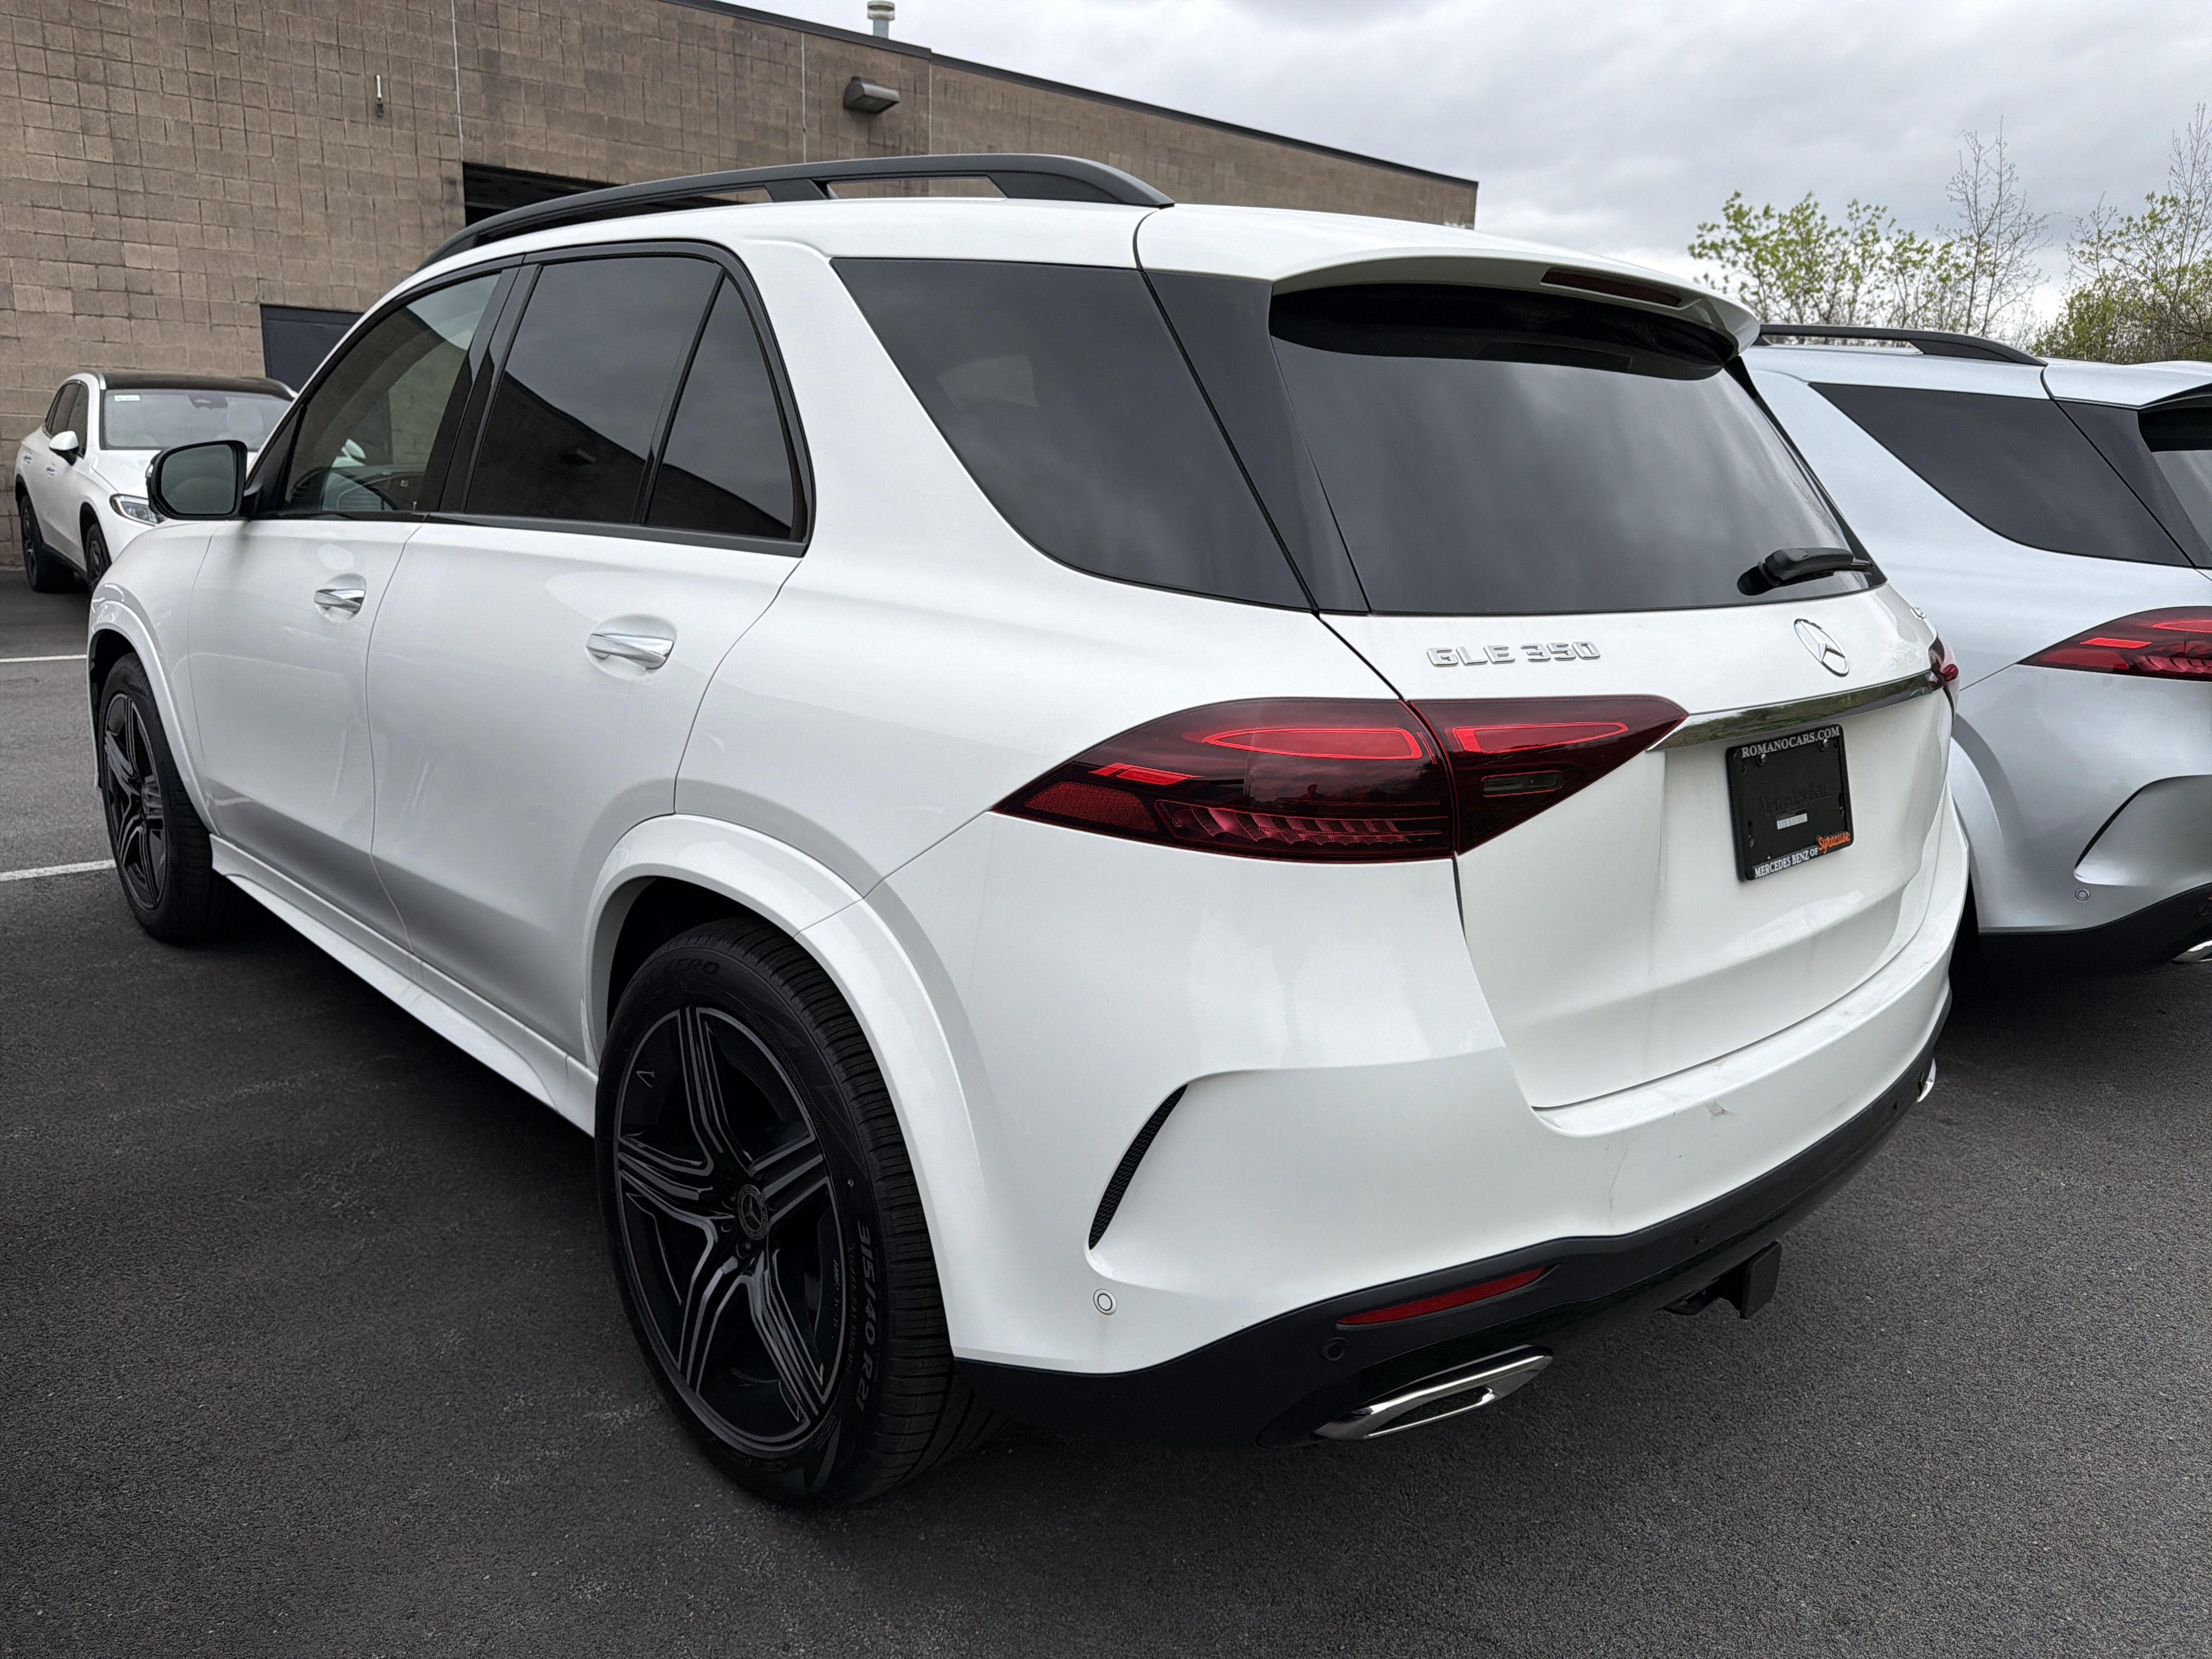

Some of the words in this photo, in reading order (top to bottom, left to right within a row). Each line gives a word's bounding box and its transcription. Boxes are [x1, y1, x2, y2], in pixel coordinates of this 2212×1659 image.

[1426, 645, 1516, 667] GLE
[1520, 641, 1601, 662] 350
[1741, 726, 1840, 758] ROMANOCARS.COM
[1818, 831, 1850, 854] Syracuse
[1754, 856, 1791, 878] MERCEDES
[1792, 850, 1809, 865] BENZ
[1810, 848, 1819, 857] OF
[857, 1220, 877, 1346] 315/40
[856, 1350, 874, 1412] R21
